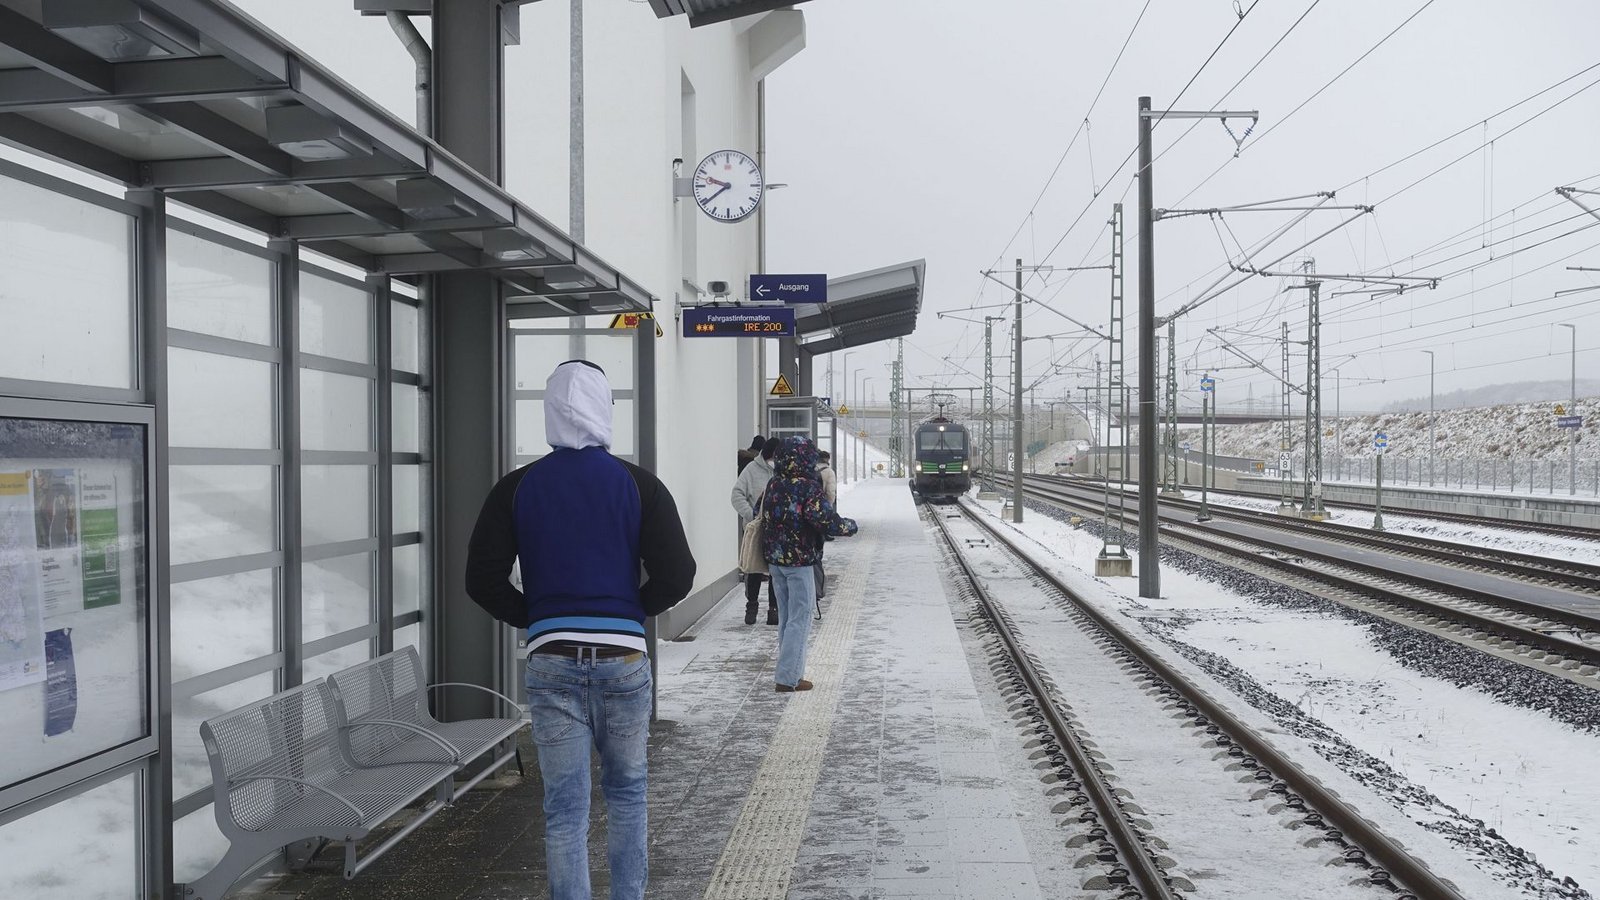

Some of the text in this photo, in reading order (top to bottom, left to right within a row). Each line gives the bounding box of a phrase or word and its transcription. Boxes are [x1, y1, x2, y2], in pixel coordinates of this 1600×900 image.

[779, 283, 809, 292] Ausgang
[707, 315, 771, 323] Fahrgastinformation
[744, 323, 782, 331] IRE 200
[1280, 452, 1290, 460] 63
